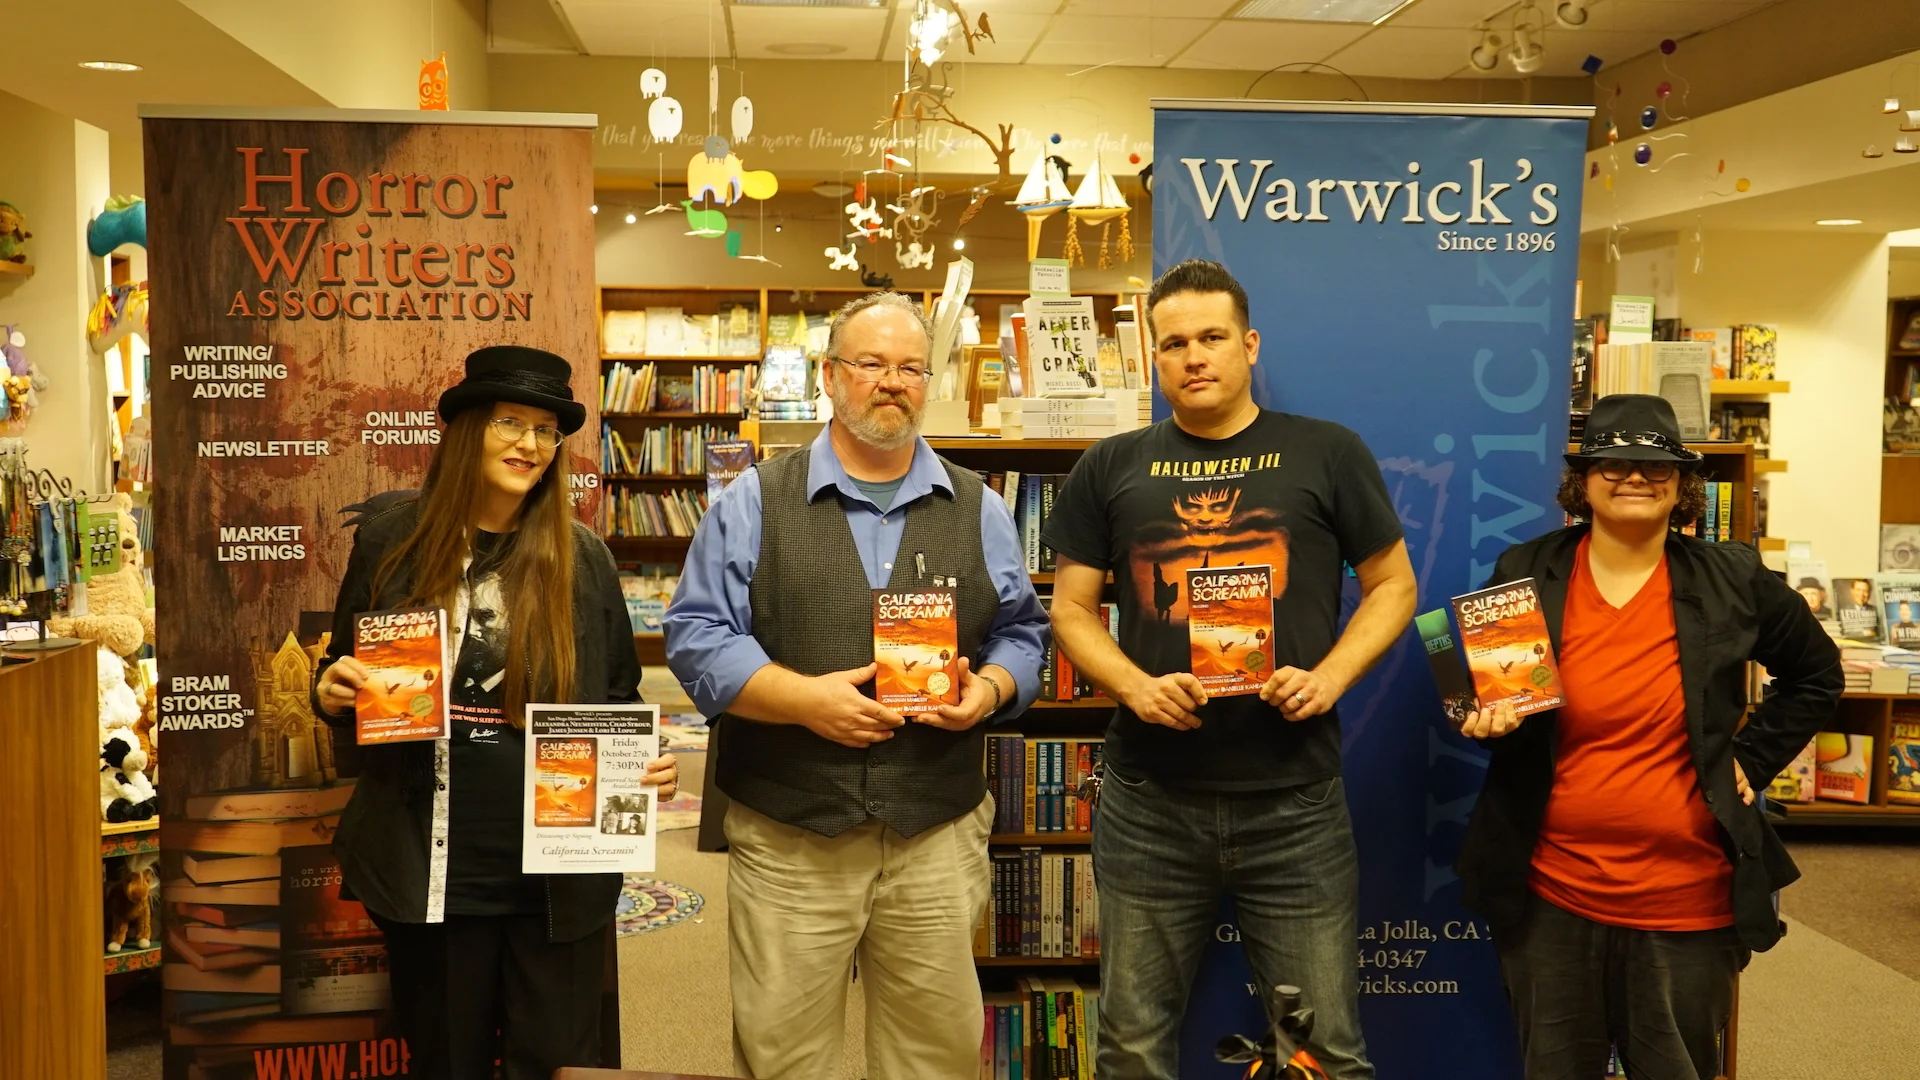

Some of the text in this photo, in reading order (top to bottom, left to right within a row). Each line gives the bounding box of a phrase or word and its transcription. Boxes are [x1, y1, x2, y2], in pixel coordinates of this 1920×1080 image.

[809, 127, 864, 157] things
[236, 147, 514, 219] Horror
[1180, 158, 1558, 225] Warwick's
[1438, 231, 1557, 252] Since 1896
[226, 217, 516, 288] Writers
[225, 290, 534, 321] ASSOCIATION
[1039, 315, 1091, 331] AFTER
[183, 345, 274, 361] WRITING/
[1051, 337, 1083, 352] THE
[170, 363, 288, 380] PUBLISHING
[1042, 356, 1097, 372] CRASH
[193, 382, 266, 399] ADVICE
[365, 410, 436, 427] ONLINE
[361, 429, 442, 445] FORUMS
[198, 440, 330, 458] NEWSLETTER
[1150, 453, 1281, 476] HALLOWEEN III
[1721, 500, 1729, 527] LEE CHILD
[219, 525, 303, 543] MARKET
[218, 544, 306, 562] LISTINGS
[1191, 572, 1268, 588] CALIFORNIA
[878, 592, 953, 605] CALIFORNIA
[1192, 583, 1269, 602] SCREAMIN'
[1460, 586, 1535, 614] CALIFORNIA
[358, 610, 437, 630] CALIFORNIA
[879, 605, 954, 619] SCREAMIN'
[1464, 596, 1537, 628] SCREAMIN'
[1424, 633, 1454, 651] DEPTHS
[171, 674, 230, 692] BRAM
[161, 694, 242, 712] STOKER
[612, 738, 640, 747] Friday
[601, 750, 650, 758] October 27th
[1027, 746, 1035, 758] ALEX
[606, 761, 645, 770] 7:30PM
[1039, 744, 1047, 783] ALEX BERENSON
[1053, 744, 1062, 783] ALEX BERENSON
[541, 845, 638, 859] California Screamin'
[289, 875, 343, 888] horro
[1379, 920, 1438, 944] Jolla,
[1443, 920, 1480, 940] CA
[253, 1038, 412, 1080] WWW.HO
